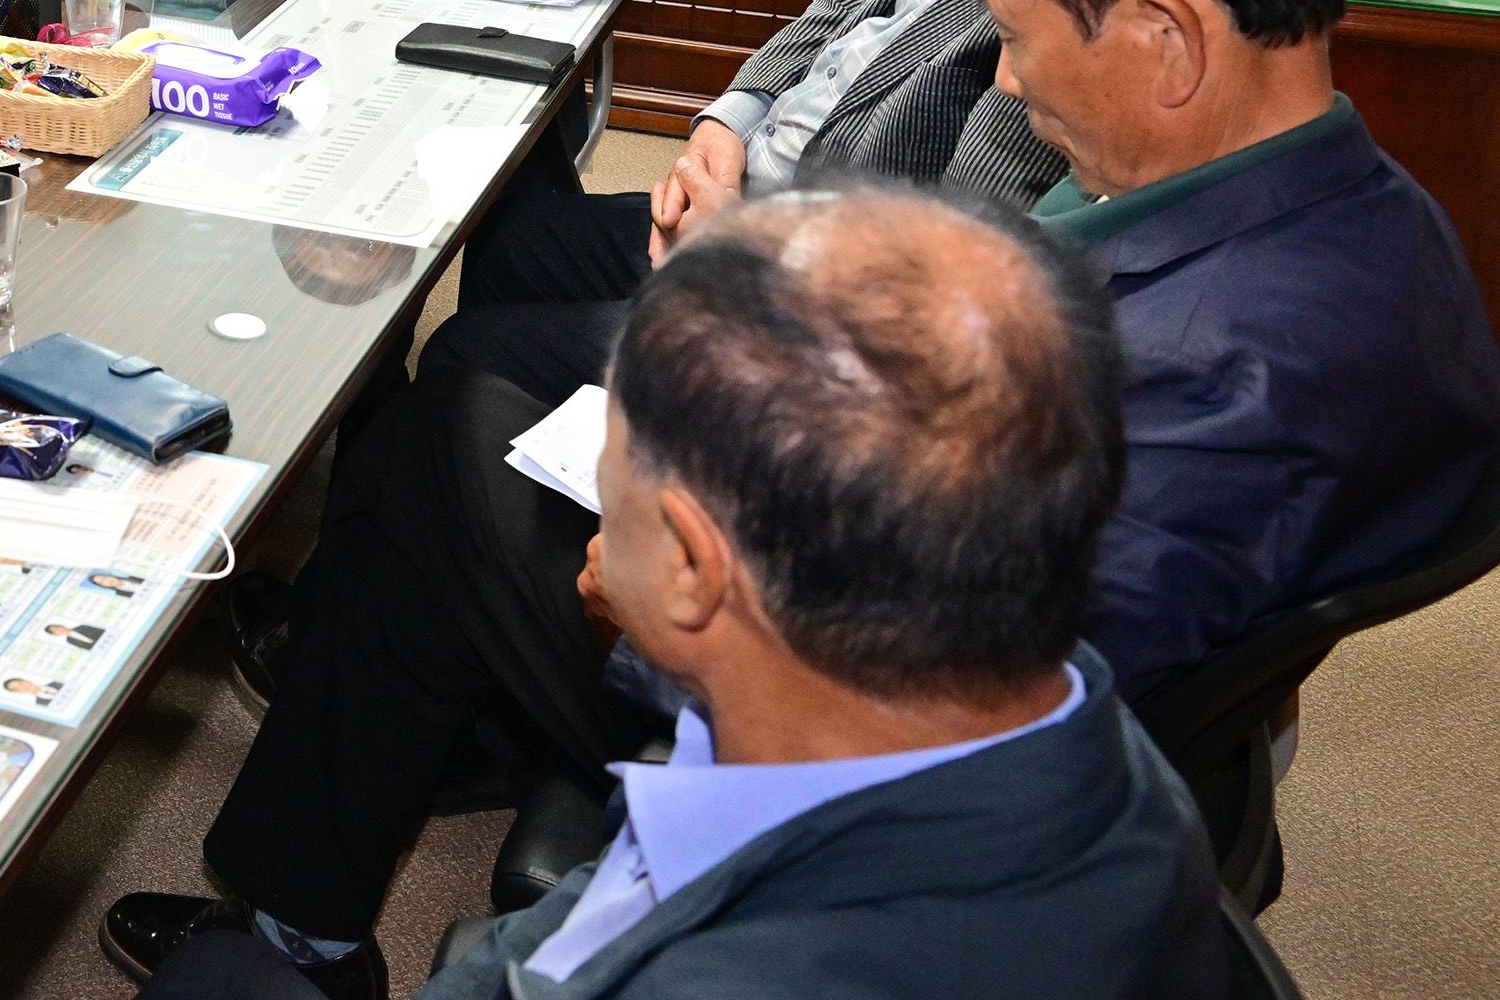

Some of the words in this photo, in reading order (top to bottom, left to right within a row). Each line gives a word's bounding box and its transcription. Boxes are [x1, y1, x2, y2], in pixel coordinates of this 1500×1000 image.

[152, 77, 210, 118] 100
[213, 92, 230, 102] BASIC
[213, 102, 225, 111] WET
[214, 111, 233, 121] TISSUE
